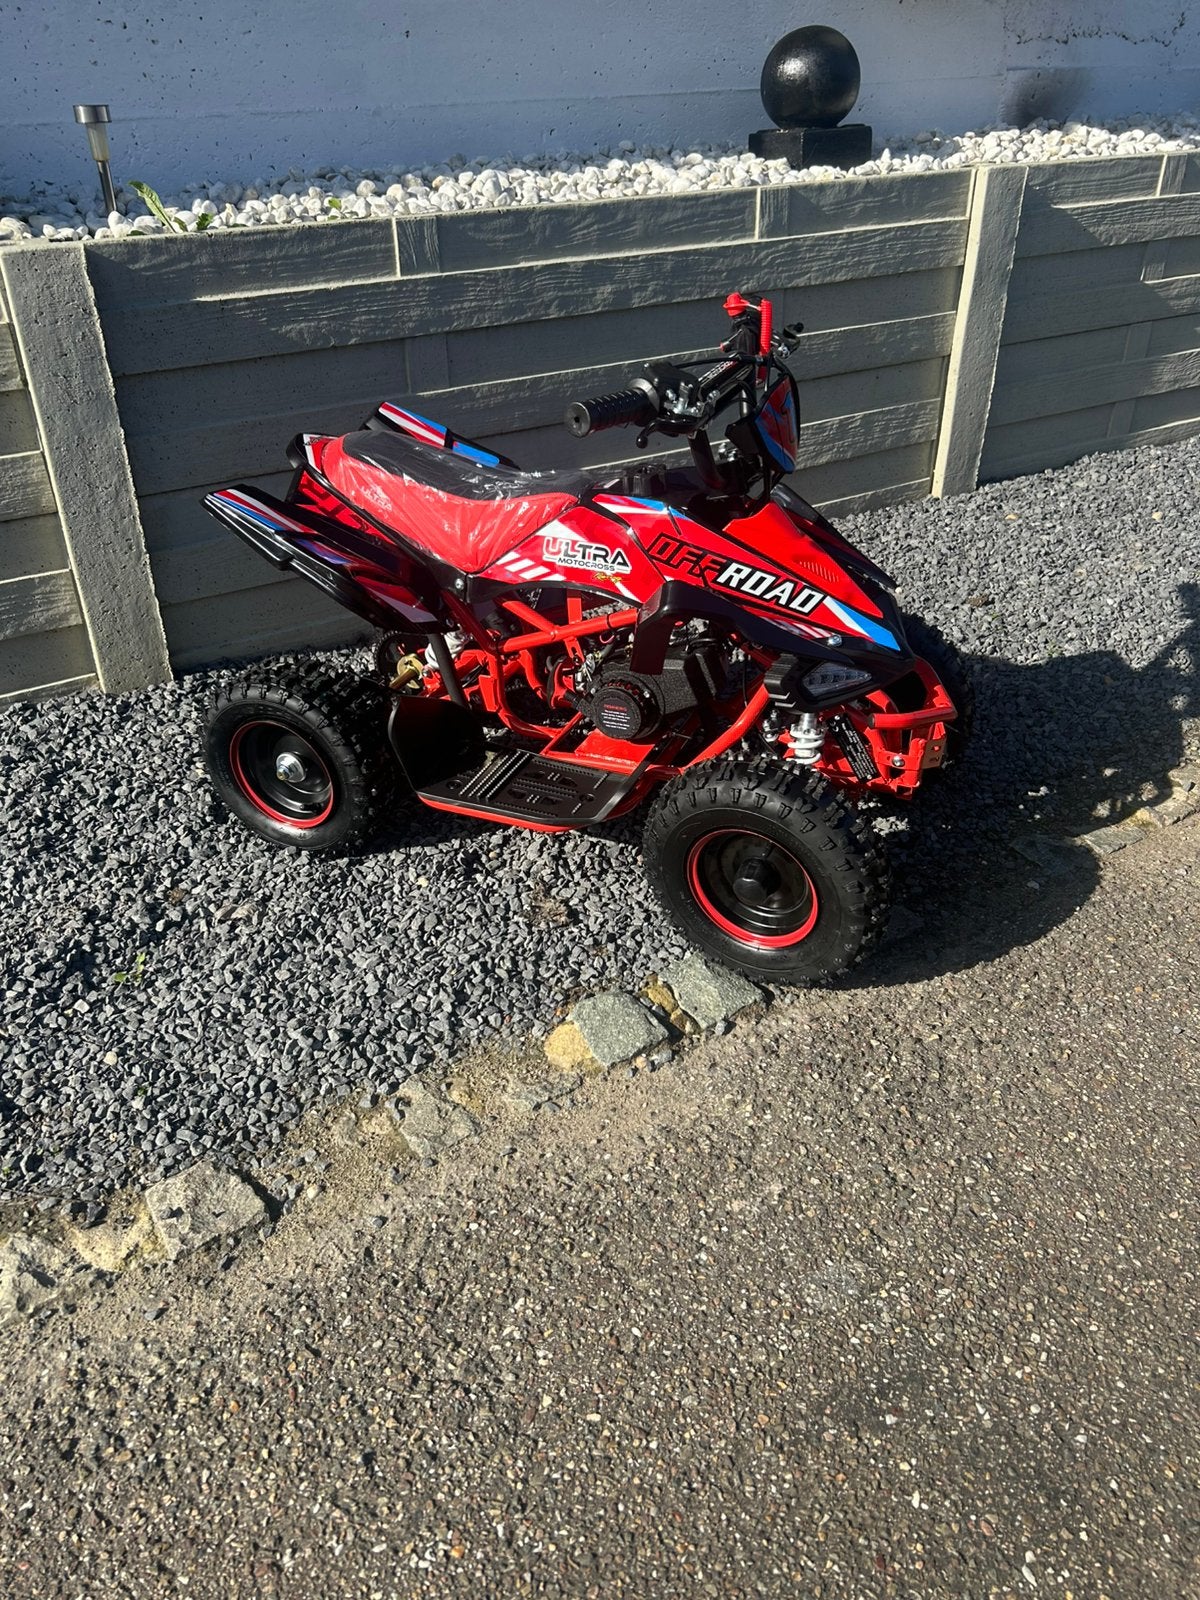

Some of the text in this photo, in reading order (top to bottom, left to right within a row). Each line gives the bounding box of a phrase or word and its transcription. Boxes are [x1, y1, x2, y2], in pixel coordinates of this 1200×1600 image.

[545, 538, 629, 567] ULTRA
[558, 557, 615, 572] MOTOCROSS
[647, 533, 824, 614] OFF ROAD
